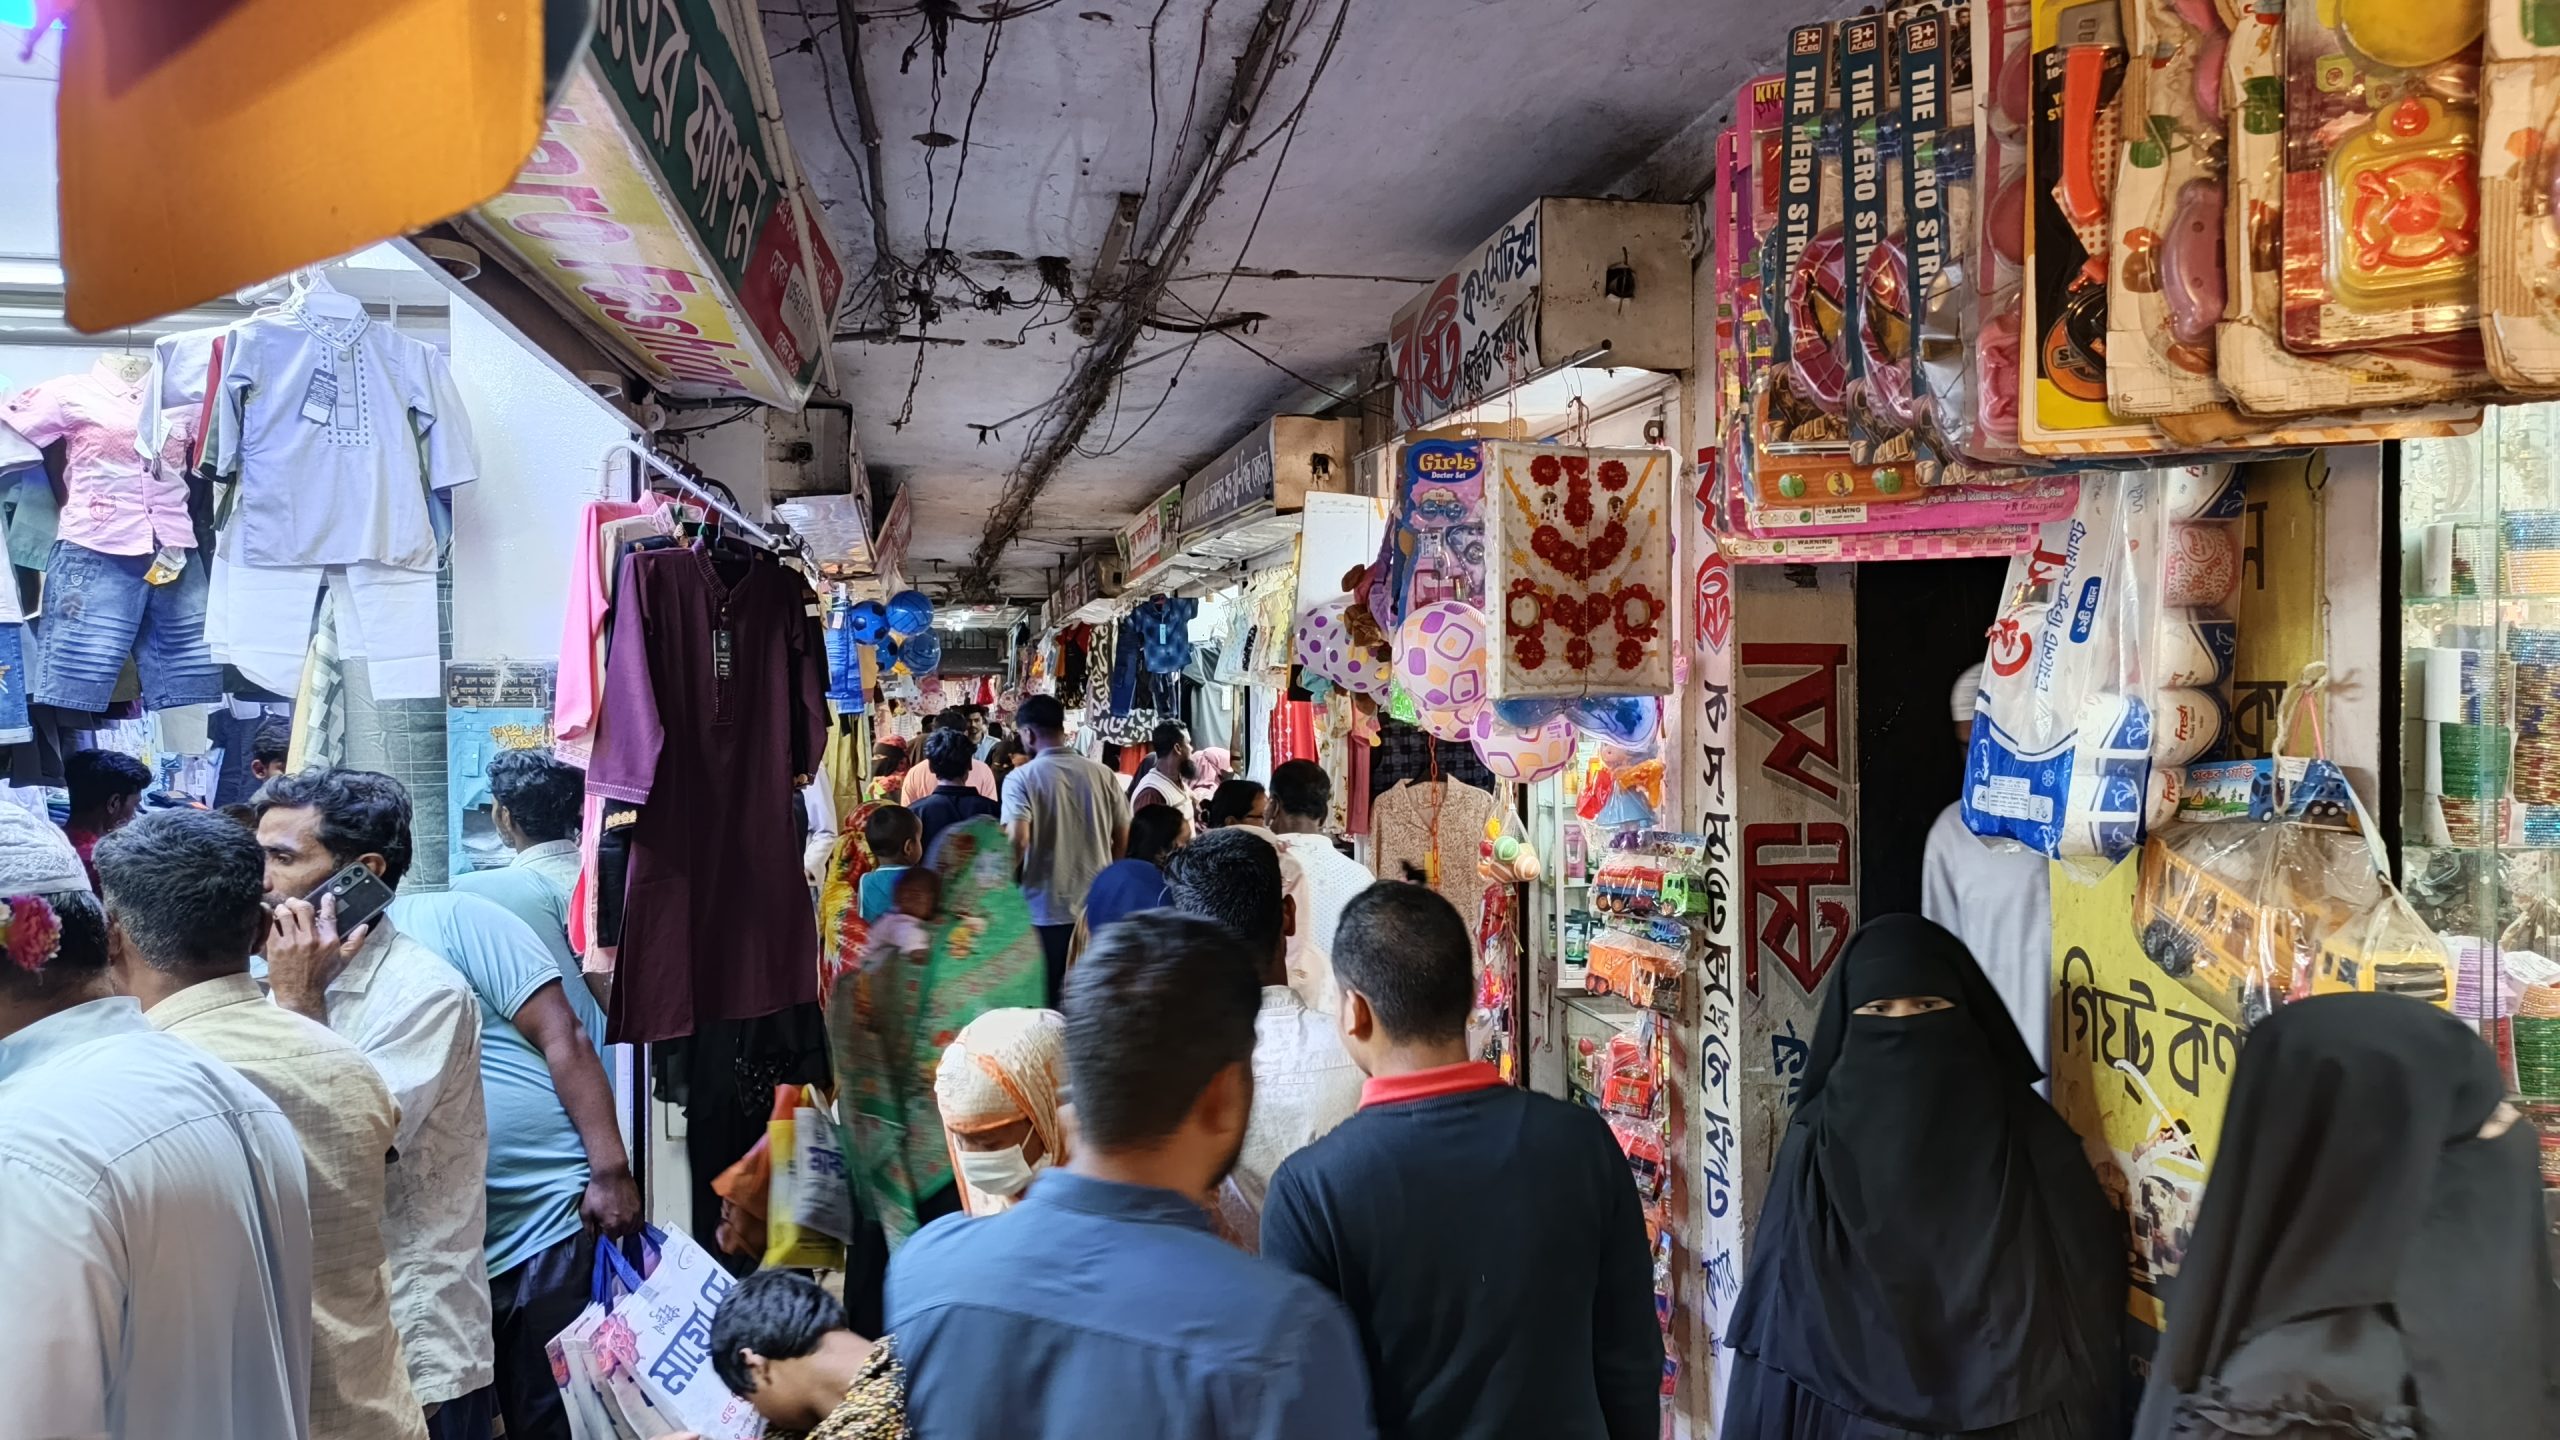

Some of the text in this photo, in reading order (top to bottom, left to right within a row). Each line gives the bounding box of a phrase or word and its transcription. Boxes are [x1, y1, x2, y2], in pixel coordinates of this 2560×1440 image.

[1793, 66, 1817, 116] THE
[1852, 64, 1875, 119] THE
[1911, 64, 1936, 122] THE
[553, 257, 752, 392] Fashion
[1419, 452, 1476, 472] Girls
[1431, 470, 1466, 479] Doctor Set
[1824, 507, 1862, 517] WARNING
[1796, 539, 1835, 548] WARNING
[2175, 704, 2189, 742] Fresh
[2161, 769, 2176, 804] Fresh
